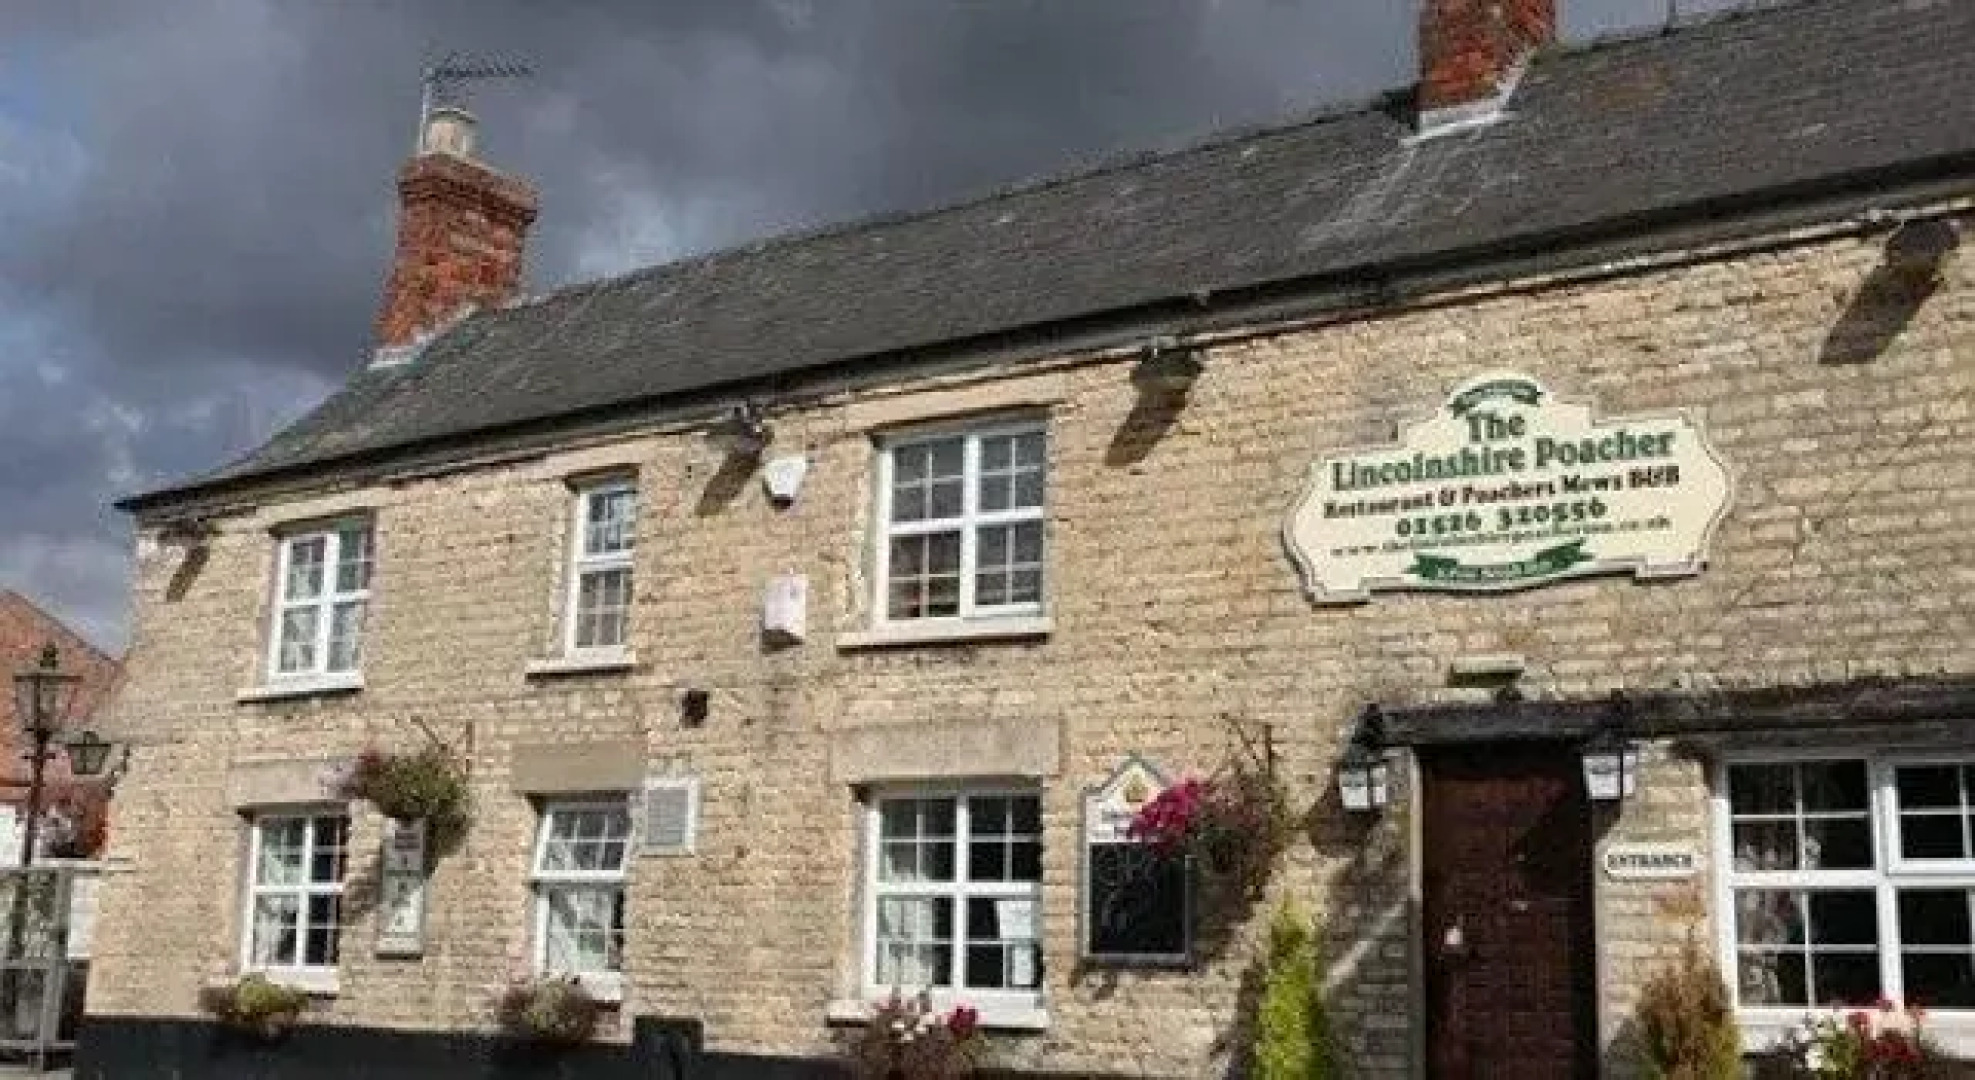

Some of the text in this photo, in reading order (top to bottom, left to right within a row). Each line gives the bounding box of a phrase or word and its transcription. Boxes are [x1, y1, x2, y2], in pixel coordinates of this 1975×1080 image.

[1464, 411, 1526, 442] The
[1332, 430, 1676, 491] Lincolnshire Poacher
[1323, 493, 1434, 519] Restaurant
[1439, 487, 1457, 507] &
[1462, 480, 1556, 505] Poachers
[1560, 473, 1624, 494] Mews
[1395, 508, 1481, 537] 01526
[1607, 853, 1692, 869] ENTRANCE
